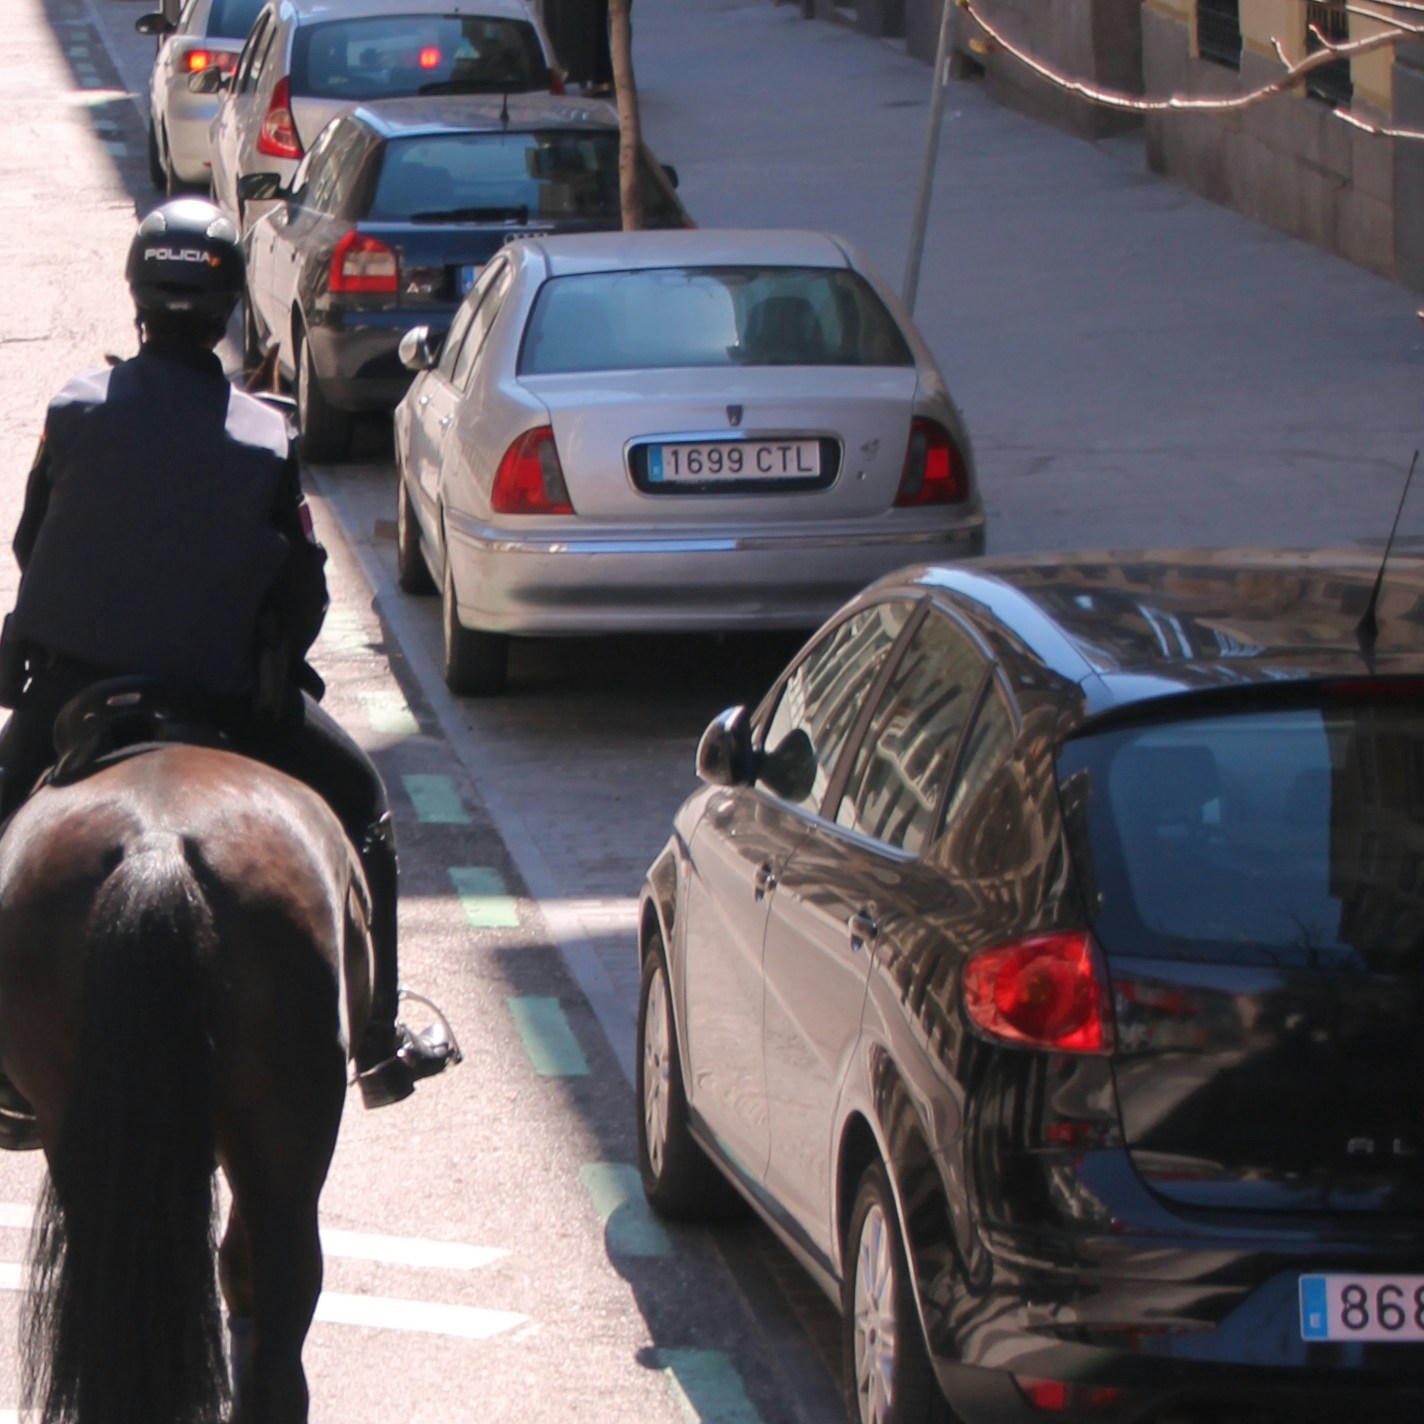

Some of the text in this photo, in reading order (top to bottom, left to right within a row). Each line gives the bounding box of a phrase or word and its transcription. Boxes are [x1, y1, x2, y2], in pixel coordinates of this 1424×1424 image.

[144, 248, 210, 262] POLICIA
[670, 446, 814, 475] 1699 CTL
